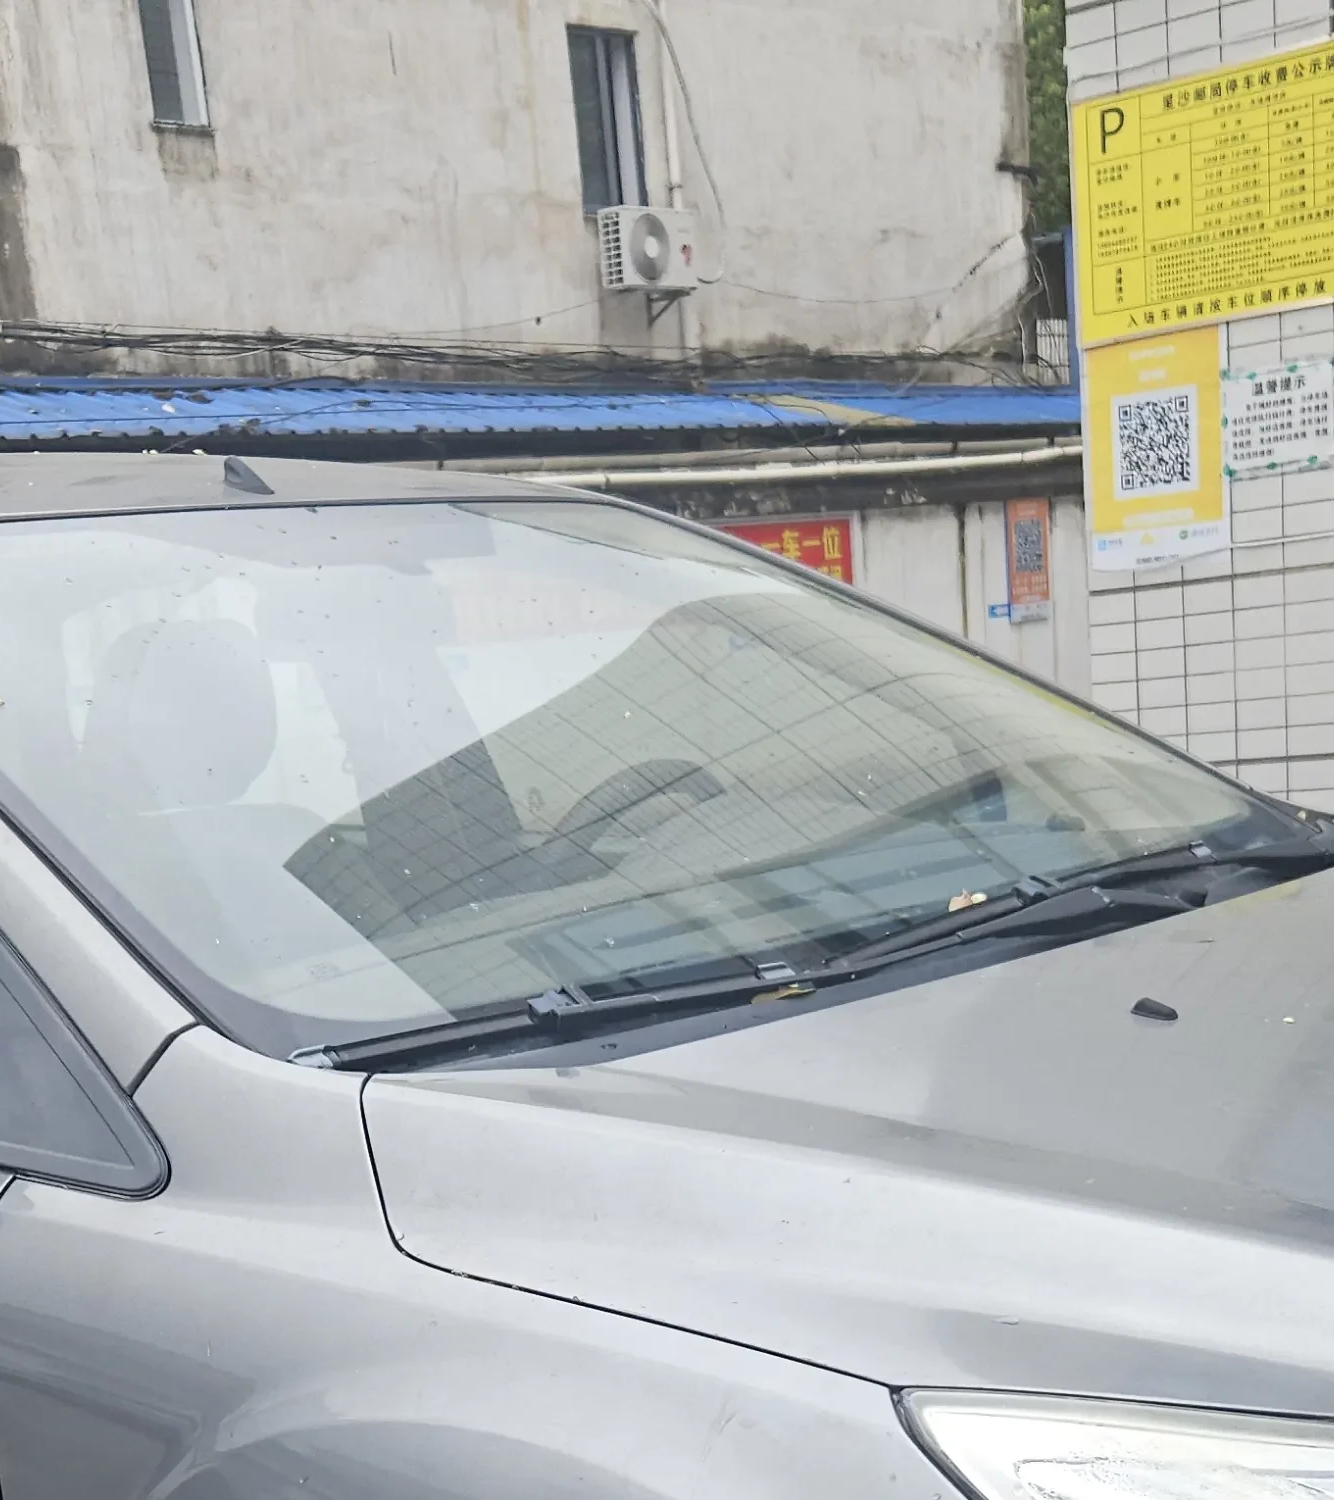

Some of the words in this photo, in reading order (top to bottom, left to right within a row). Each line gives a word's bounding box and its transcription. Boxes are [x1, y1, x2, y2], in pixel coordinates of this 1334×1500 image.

[1100, 106, 1124, 155] P
[1252, 375, 1307, 397] 温馨提示
